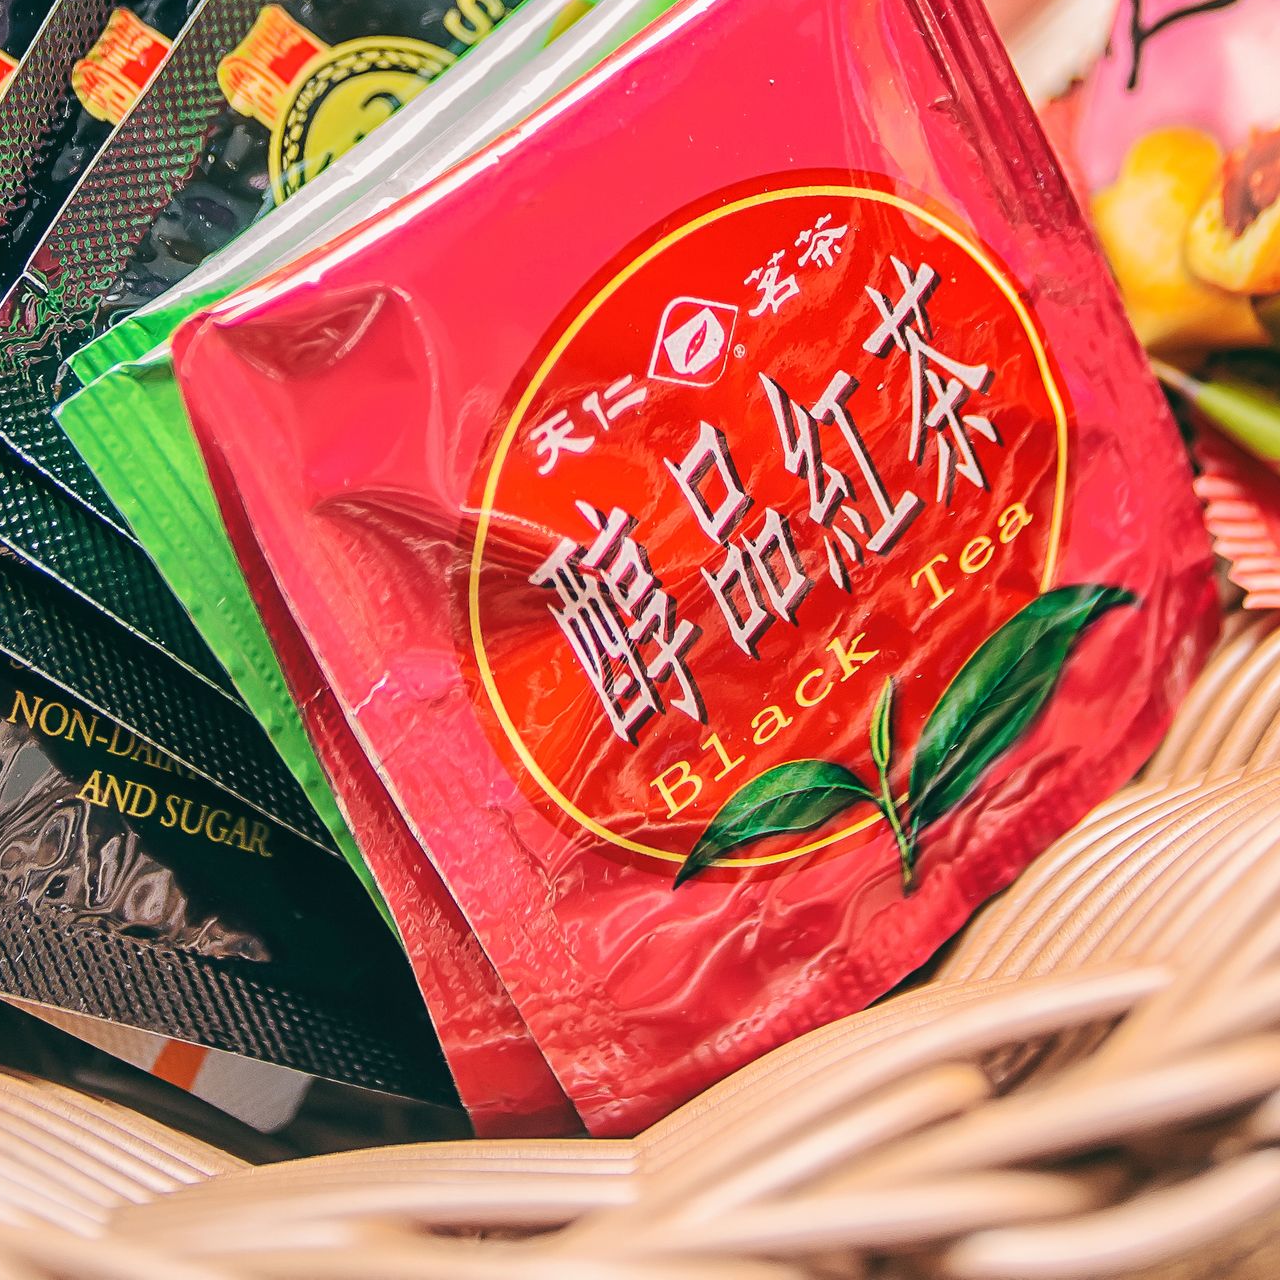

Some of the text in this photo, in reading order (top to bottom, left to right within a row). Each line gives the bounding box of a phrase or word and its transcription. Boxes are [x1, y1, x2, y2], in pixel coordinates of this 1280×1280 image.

[530, 213, 848, 475] 天仁 茗茶
[527, 254, 1000, 743] 醇品紅茶
[651, 501, 1034, 820] Black Tea
[75, 769, 274, 858] AND SUGAR
